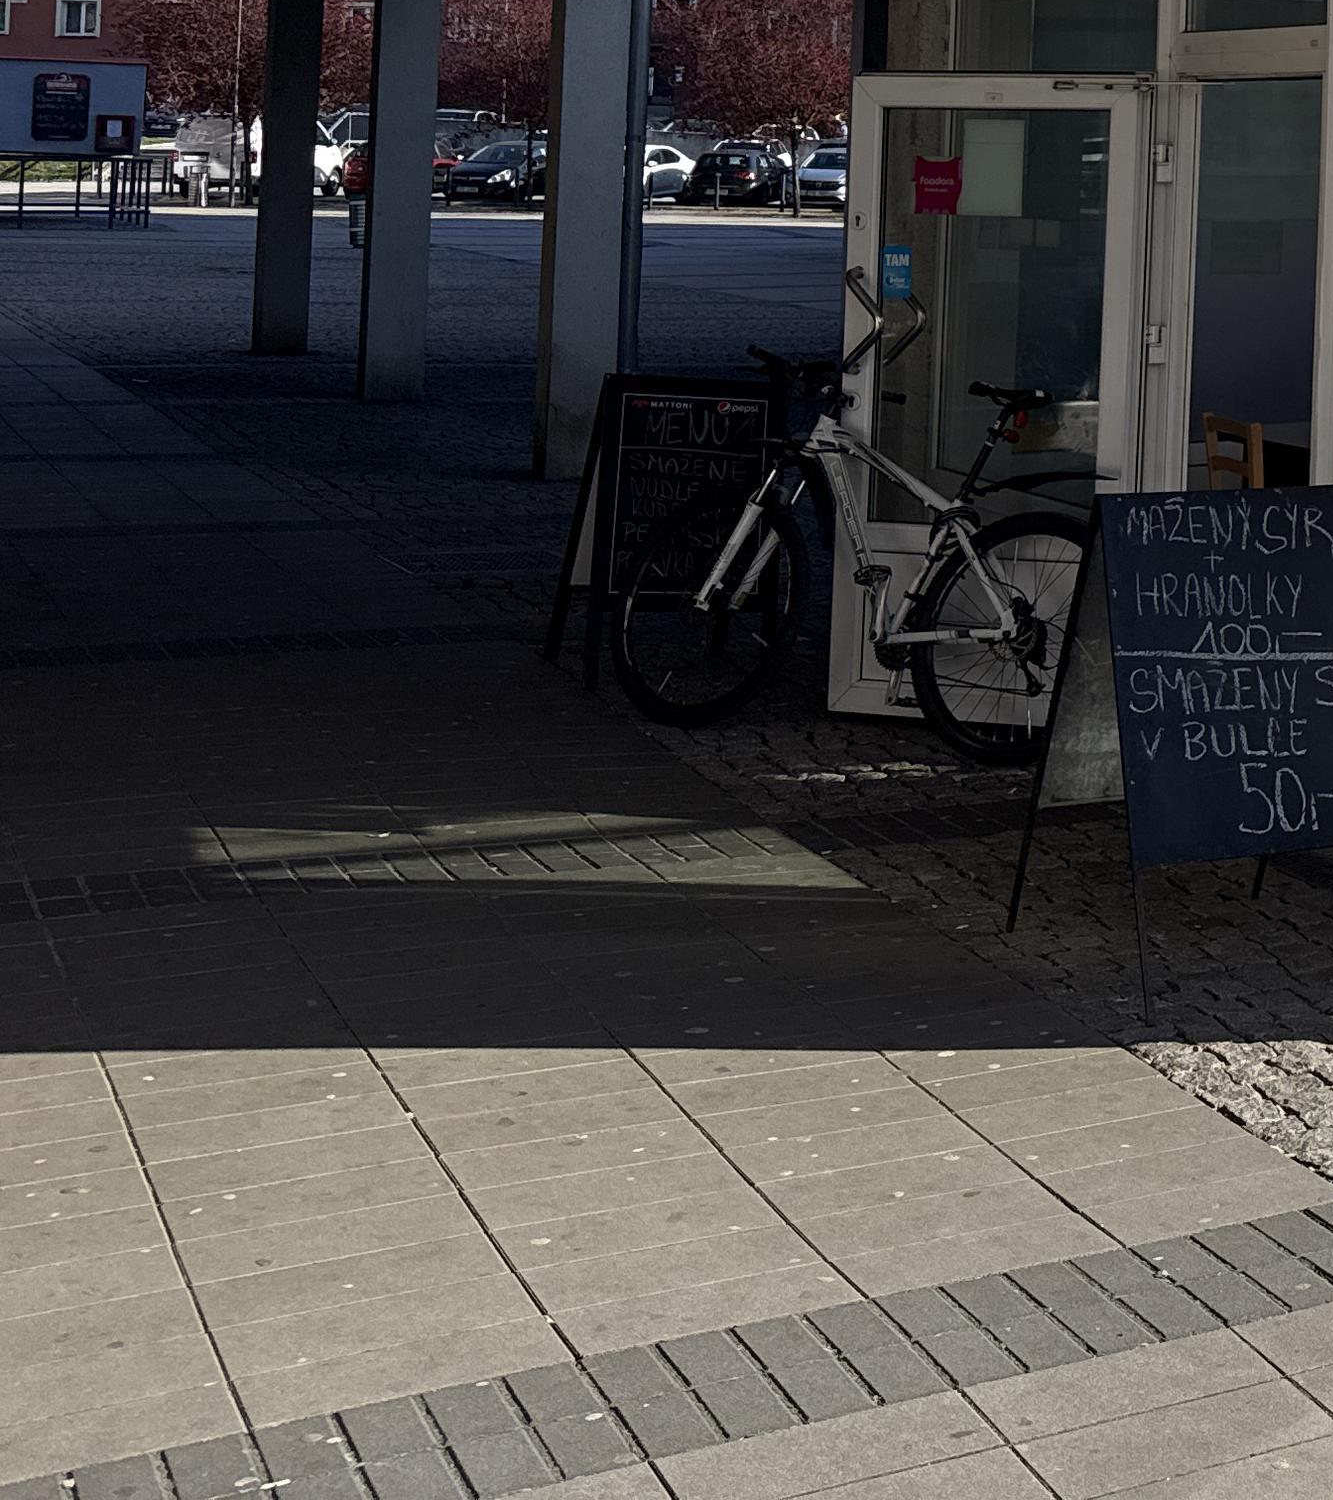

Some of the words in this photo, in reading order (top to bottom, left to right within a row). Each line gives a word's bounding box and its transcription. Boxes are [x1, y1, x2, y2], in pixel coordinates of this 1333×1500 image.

[884, 253, 910, 267] TAM
[644, 408, 730, 446] MENU
[650, 401, 693, 410] MATTONI
[731, 404, 759, 415] pepsi
[1119, 496, 1251, 551] MAŽENÝ
[1135, 570, 1304, 620] HRANOLKY
[1181, 716, 1309, 762] BULCE
